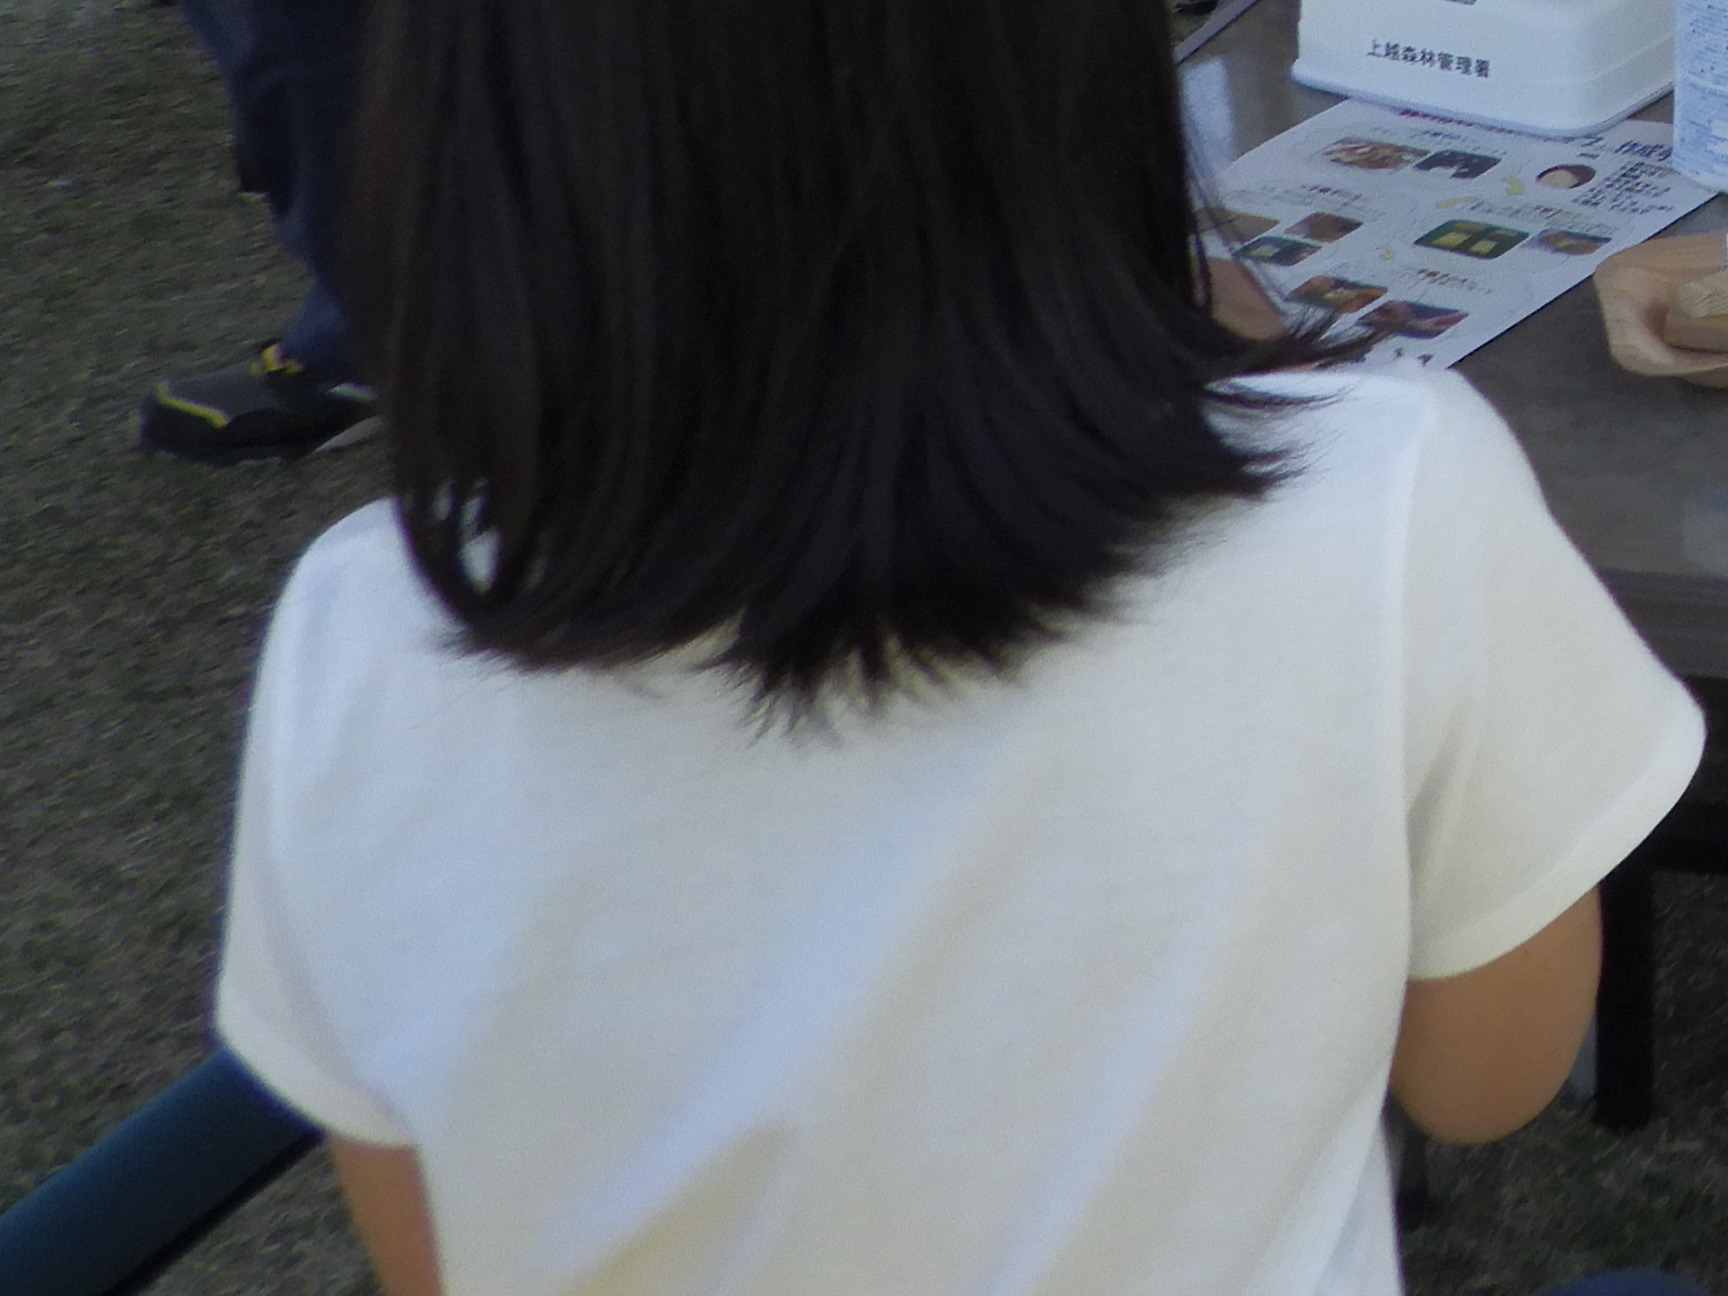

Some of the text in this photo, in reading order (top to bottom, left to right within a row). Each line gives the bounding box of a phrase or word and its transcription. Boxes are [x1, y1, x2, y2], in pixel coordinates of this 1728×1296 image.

[1366, 38, 1491, 79] 上越森林管理署
